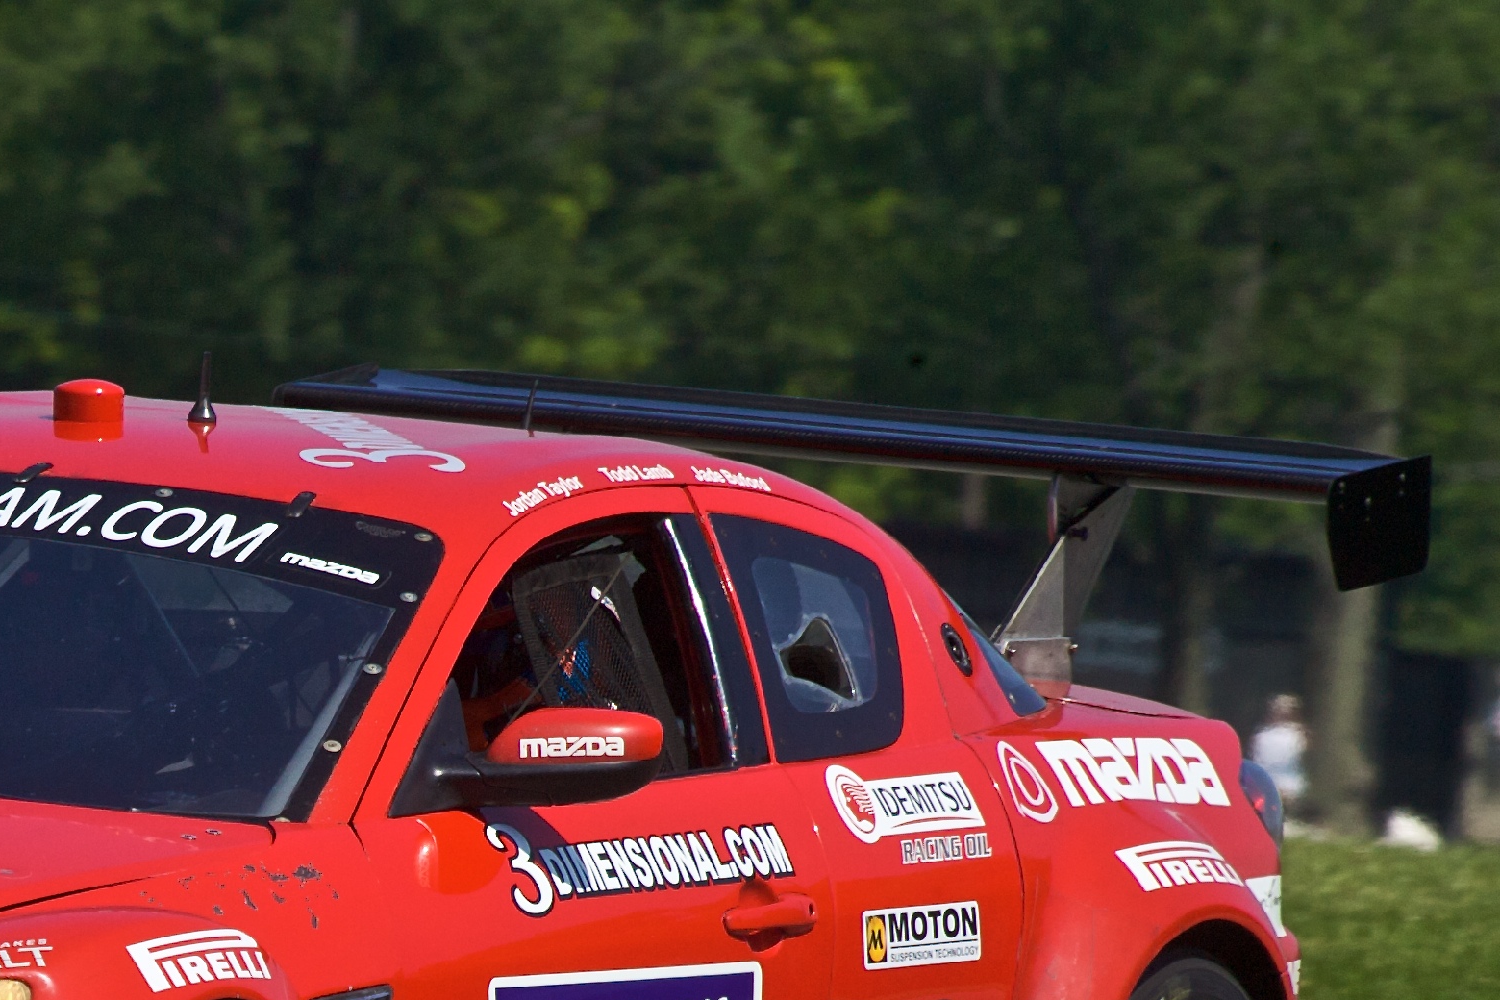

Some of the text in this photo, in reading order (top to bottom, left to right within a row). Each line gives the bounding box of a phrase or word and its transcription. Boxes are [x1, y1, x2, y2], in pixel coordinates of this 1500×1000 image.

[598, 464, 674, 482] Todd Lamb
[503, 475, 583, 516] Jordan Taylor
[280, 549, 381, 585] mazda
[519, 736, 625, 759] mazda
[1035, 737, 1231, 808] mazda
[873, 779, 973, 818] IDEMITSU
[901, 833, 992, 865] RACING OIL
[1114, 840, 1245, 892] PIRELLI
[887, 906, 978, 942] MOTON
[126, 928, 273, 994] PIRELLI
[890, 946, 979, 963] SUSPENSION TECHNOLOGY
